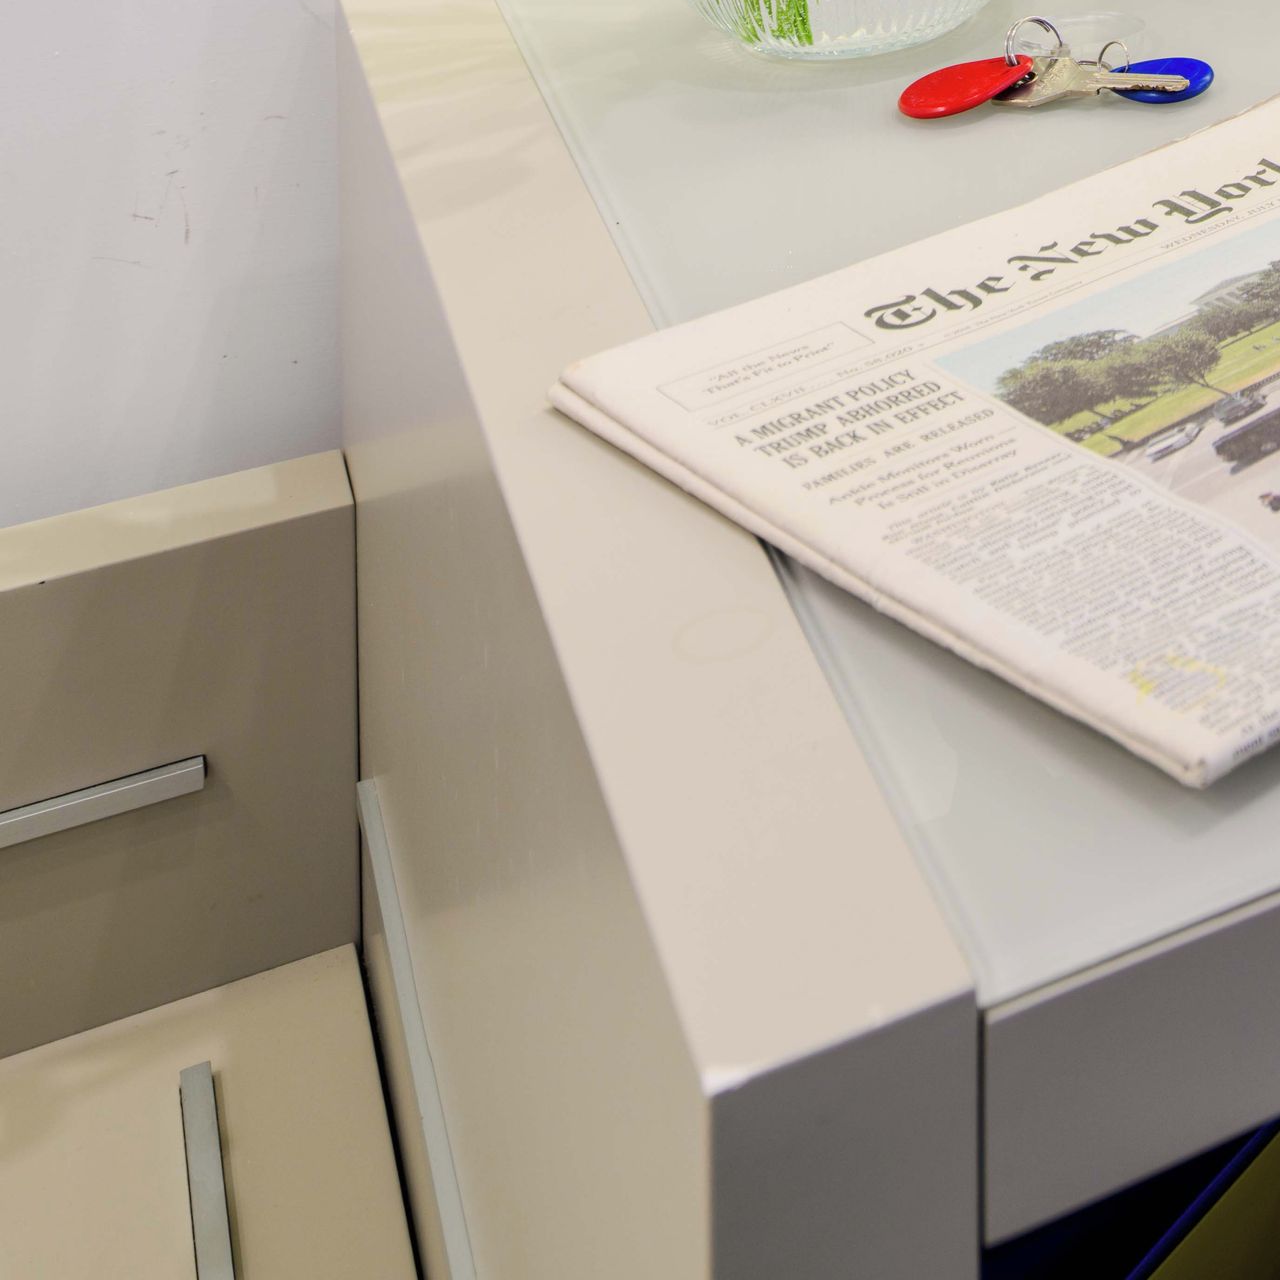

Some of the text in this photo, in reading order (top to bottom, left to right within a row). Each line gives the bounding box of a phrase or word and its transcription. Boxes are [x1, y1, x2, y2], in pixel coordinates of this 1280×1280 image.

[1246, 200, 1275, 216] JULY
[864, 276, 1009, 331] The
[1007, 218, 1158, 281] New
[734, 369, 915, 447] A MIGRANT POLICY
[758, 381, 941, 457] TRUMP ABHORRED
[781, 391, 964, 469] IS BACK IN EFFECT
[949, 435, 995, 453] Worn
[802, 409, 995, 490] FAMILIES ARE RELEASED
[853, 479, 915, 507] Process
[916, 468, 941, 481] for
[895, 485, 929, 500] Still
[933, 478, 951, 488] in
